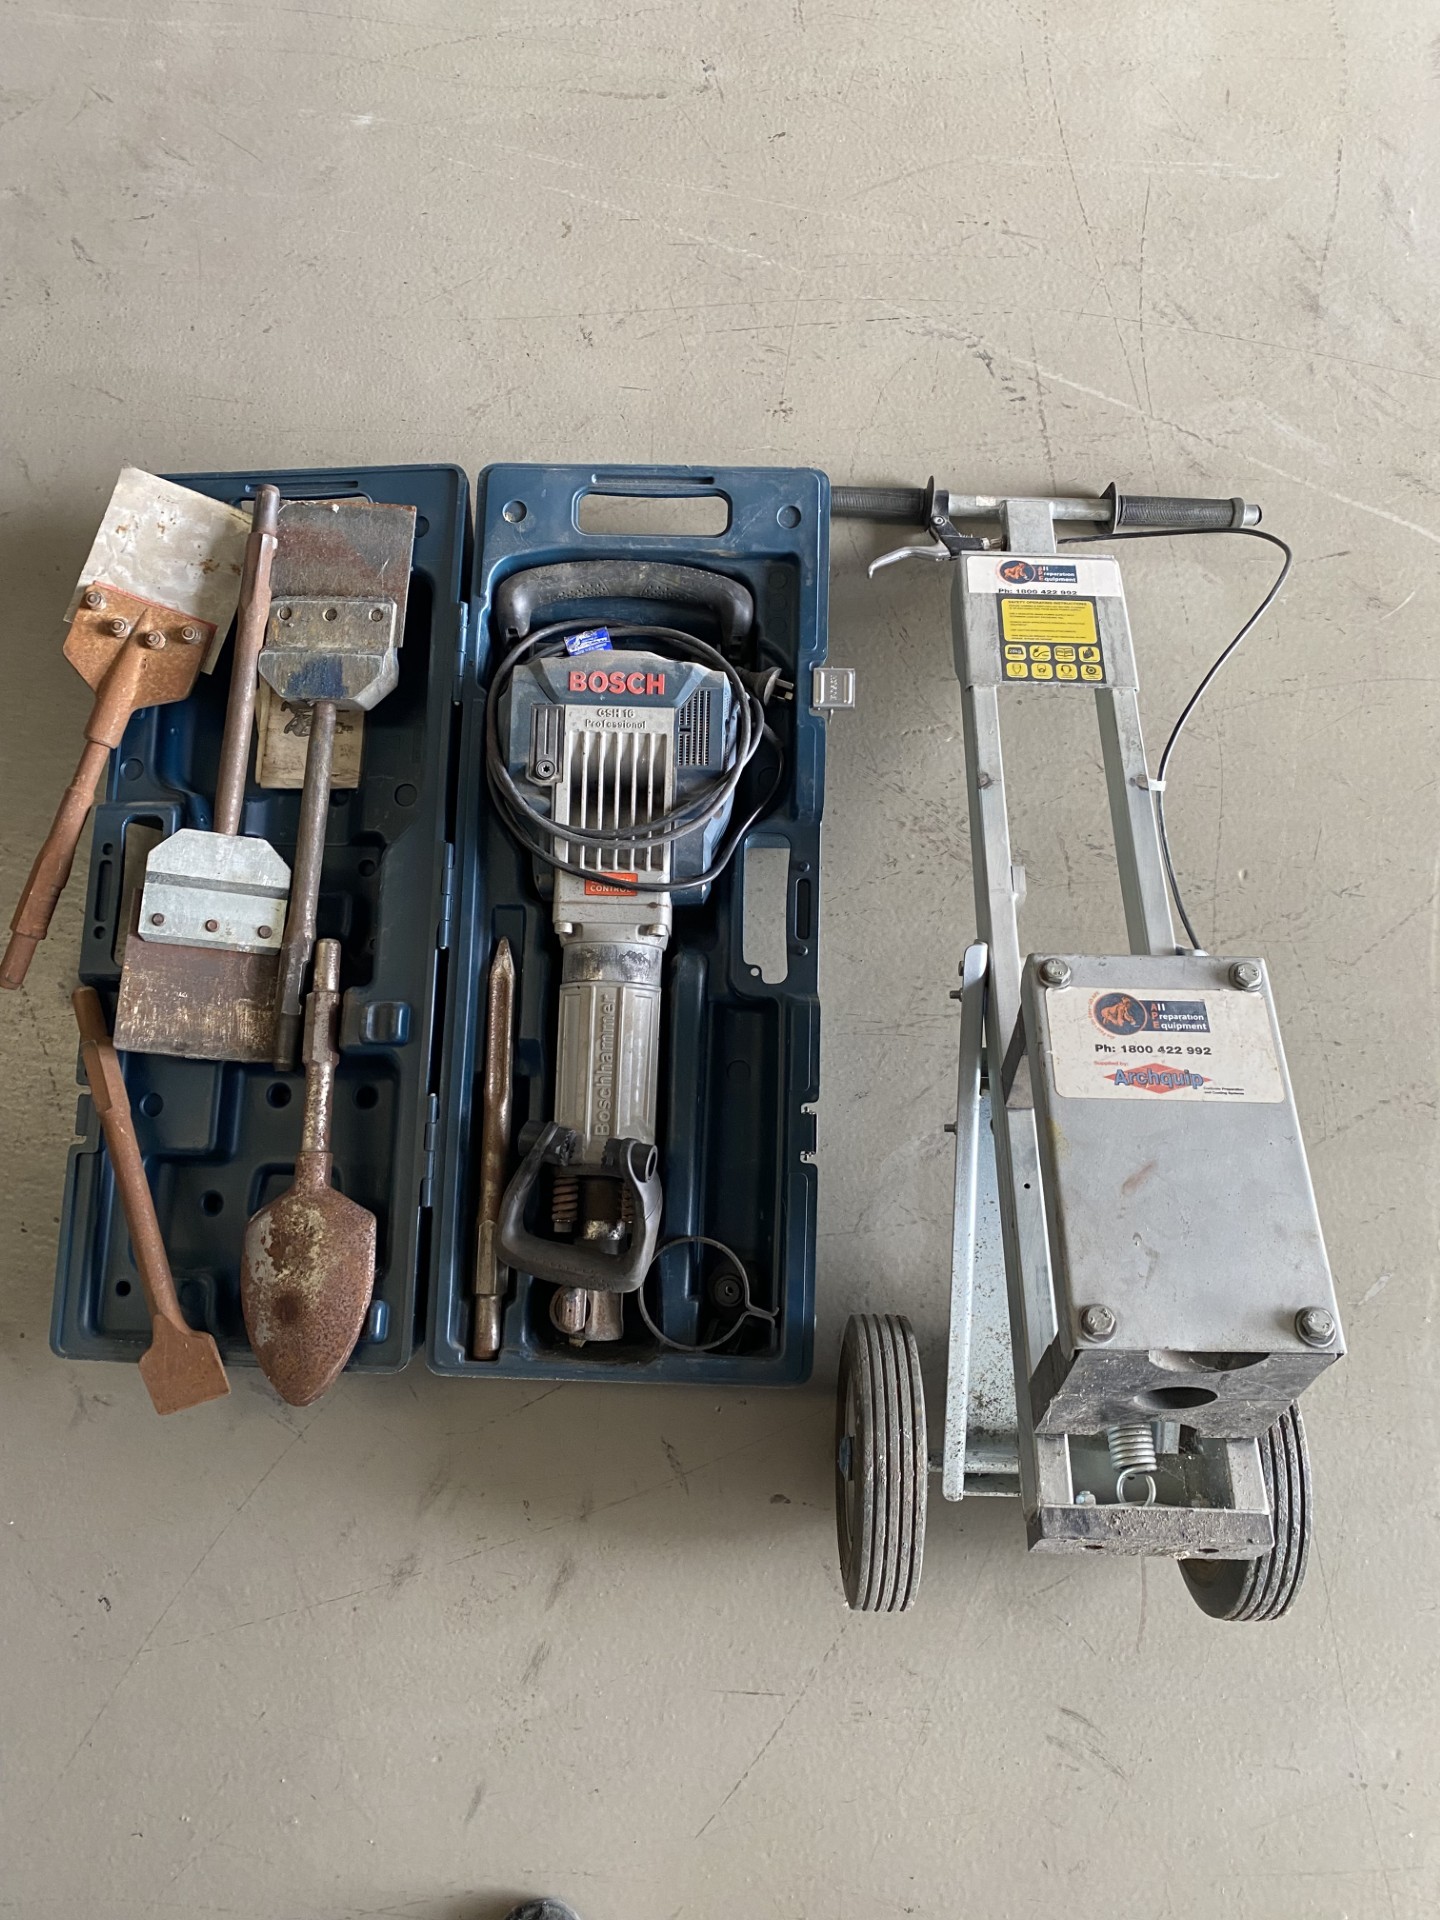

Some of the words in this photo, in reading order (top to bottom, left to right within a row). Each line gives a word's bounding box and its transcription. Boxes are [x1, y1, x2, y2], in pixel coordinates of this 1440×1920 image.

[569, 671, 666, 695] BOSCH
[597, 708, 621, 718] GSH
[585, 719, 647, 729] Professional
[1151, 1003, 1166, 1011] All
[1151, 1011, 1204, 1021] Preparation
[1152, 1021, 1208, 1030] Equipment
[1095, 1044, 1116, 1053] Ph:
[1121, 1045, 1153, 1053] 1800
[1157, 1046, 1183, 1055] 422
[1187, 1046, 1212, 1055] 992
[595, 994, 615, 1136] Boschhammer
[1114, 1069, 1204, 1089] Archquip
